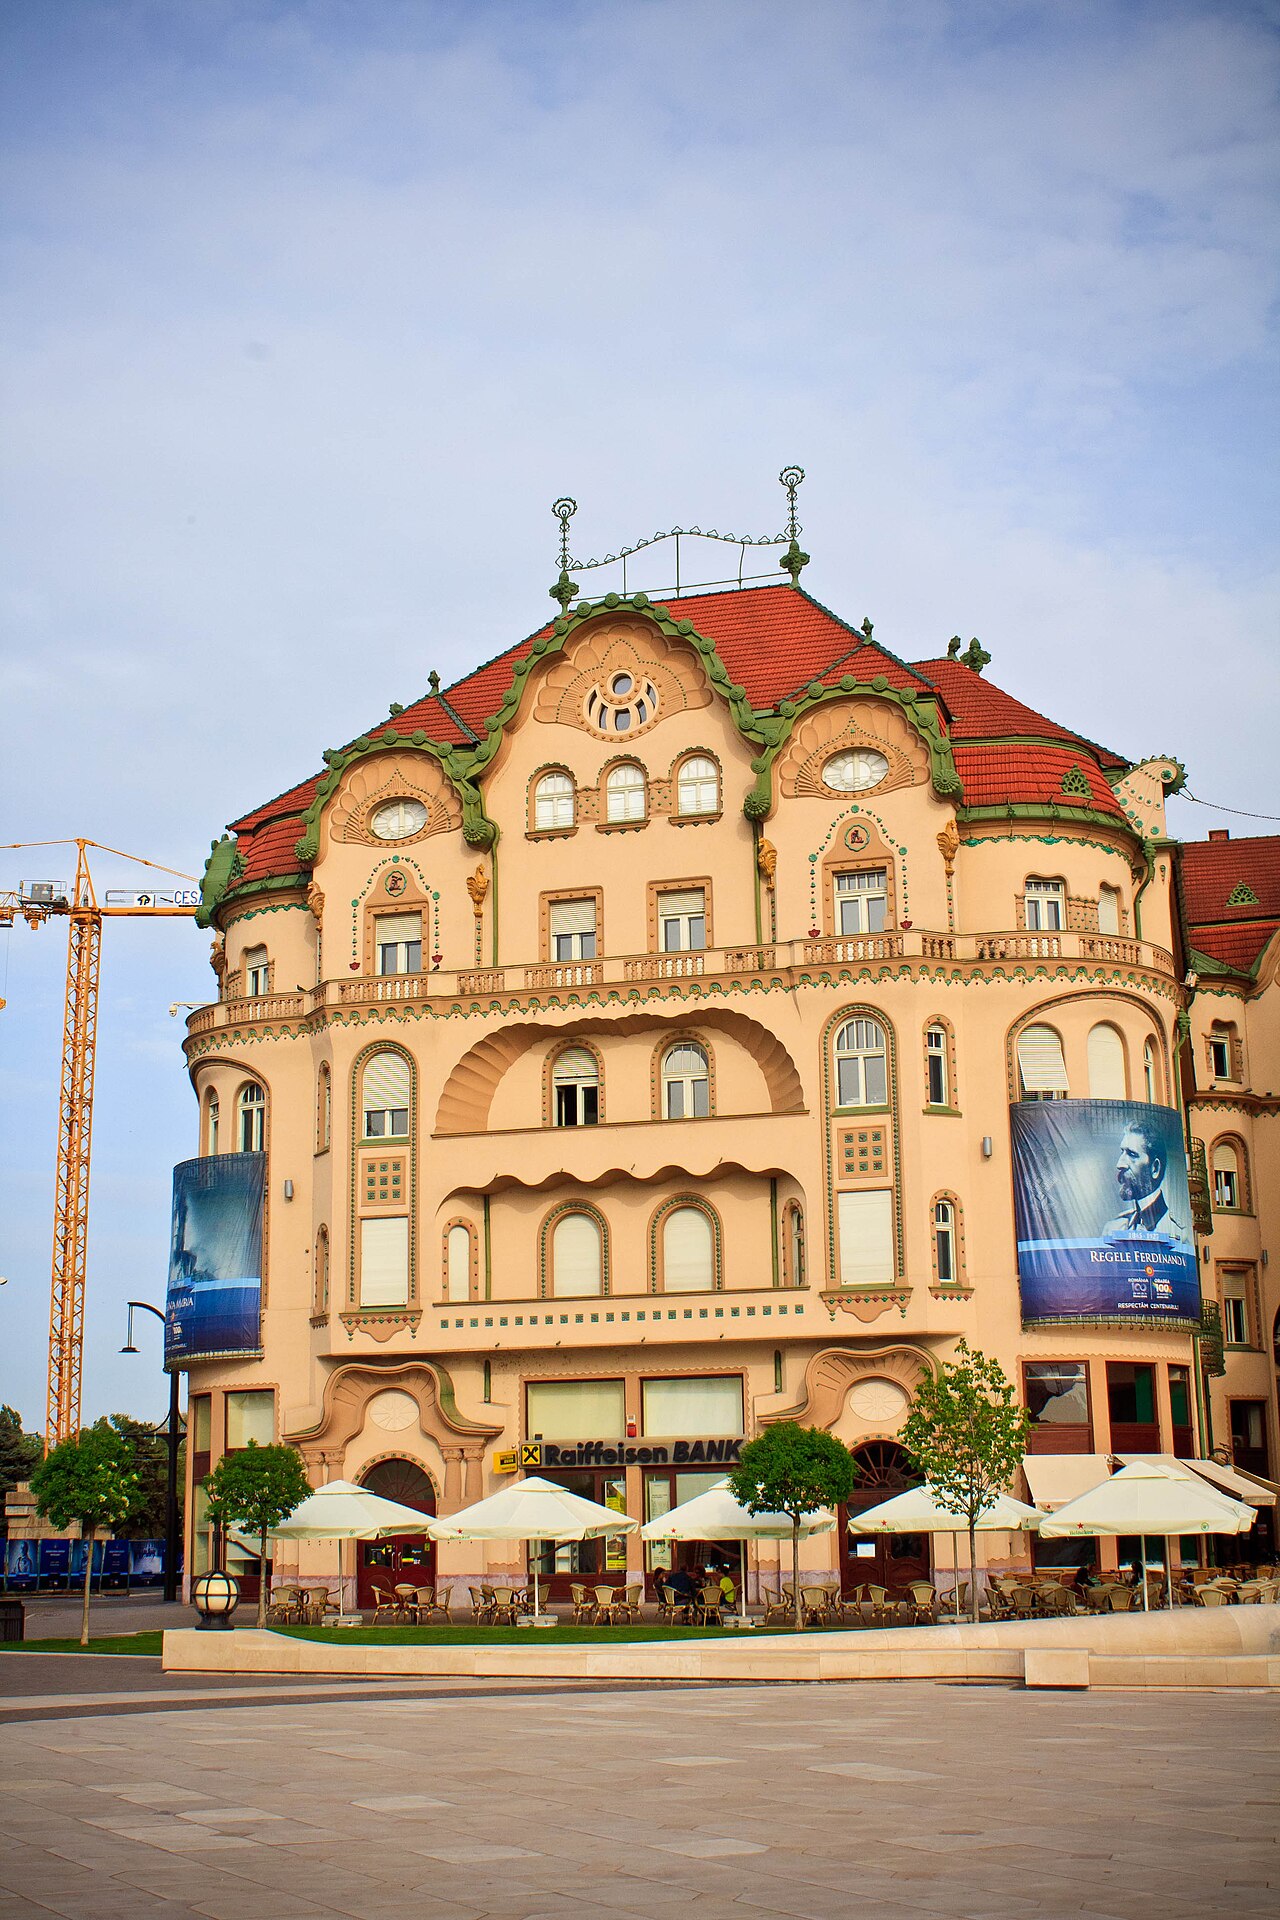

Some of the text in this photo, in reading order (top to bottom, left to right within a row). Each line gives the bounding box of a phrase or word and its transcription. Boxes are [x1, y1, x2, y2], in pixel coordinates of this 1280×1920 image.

[1090, 1250, 1132, 1263] REGELE
[1155, 1283, 1169, 1293] 100
[544, 1439, 744, 1466] Raiffeisen BANK
